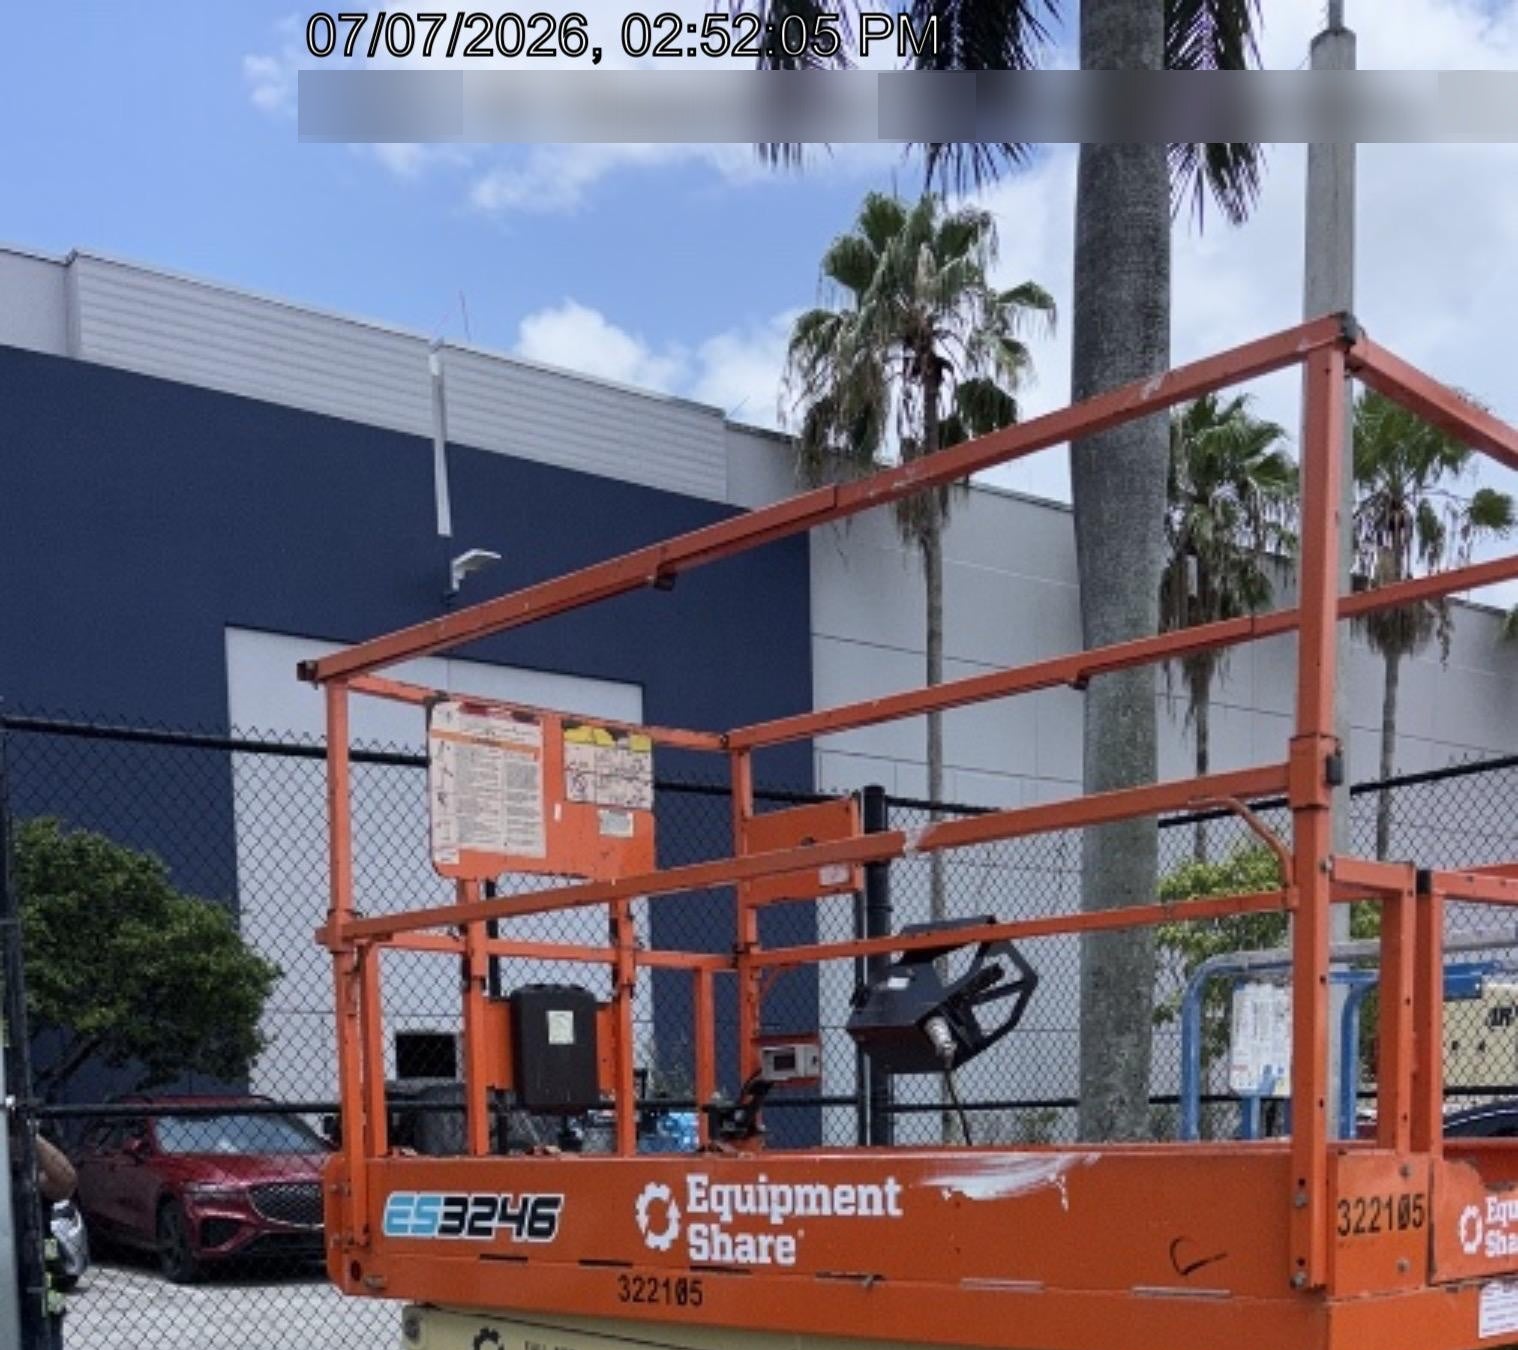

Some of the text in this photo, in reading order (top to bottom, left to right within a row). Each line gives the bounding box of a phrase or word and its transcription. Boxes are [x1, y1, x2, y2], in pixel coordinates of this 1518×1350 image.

[383, 1191, 564, 1242] ES3246
[686, 1174, 903, 1224] Equipment
[1337, 1193, 1425, 1236] 322105
[686, 1223, 796, 1266] Share
[617, 1274, 703, 1307] 322105
